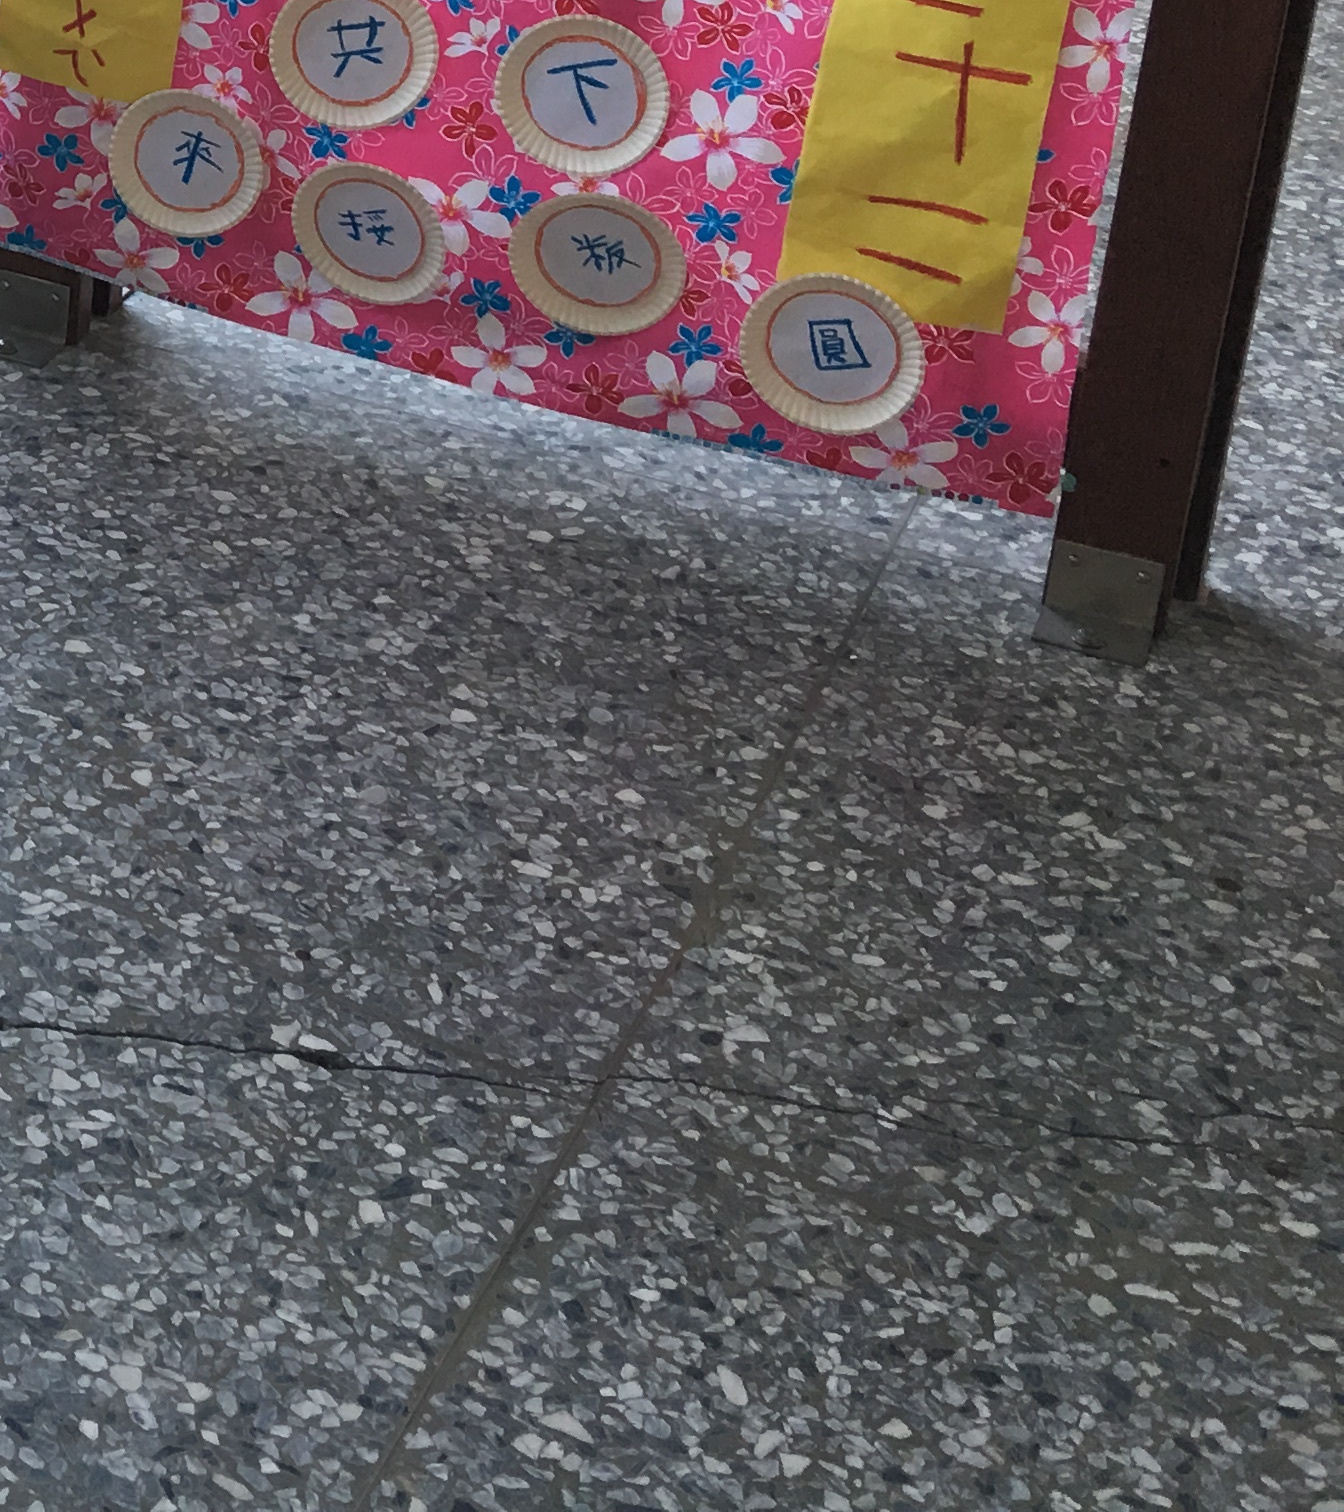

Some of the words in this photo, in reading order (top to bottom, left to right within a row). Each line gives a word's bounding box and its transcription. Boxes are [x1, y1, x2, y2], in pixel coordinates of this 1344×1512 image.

[327, 15, 386, 78] 共
[546, 58, 619, 126] 下
[172, 131, 224, 185] 來
[807, 318, 873, 371] 圓
